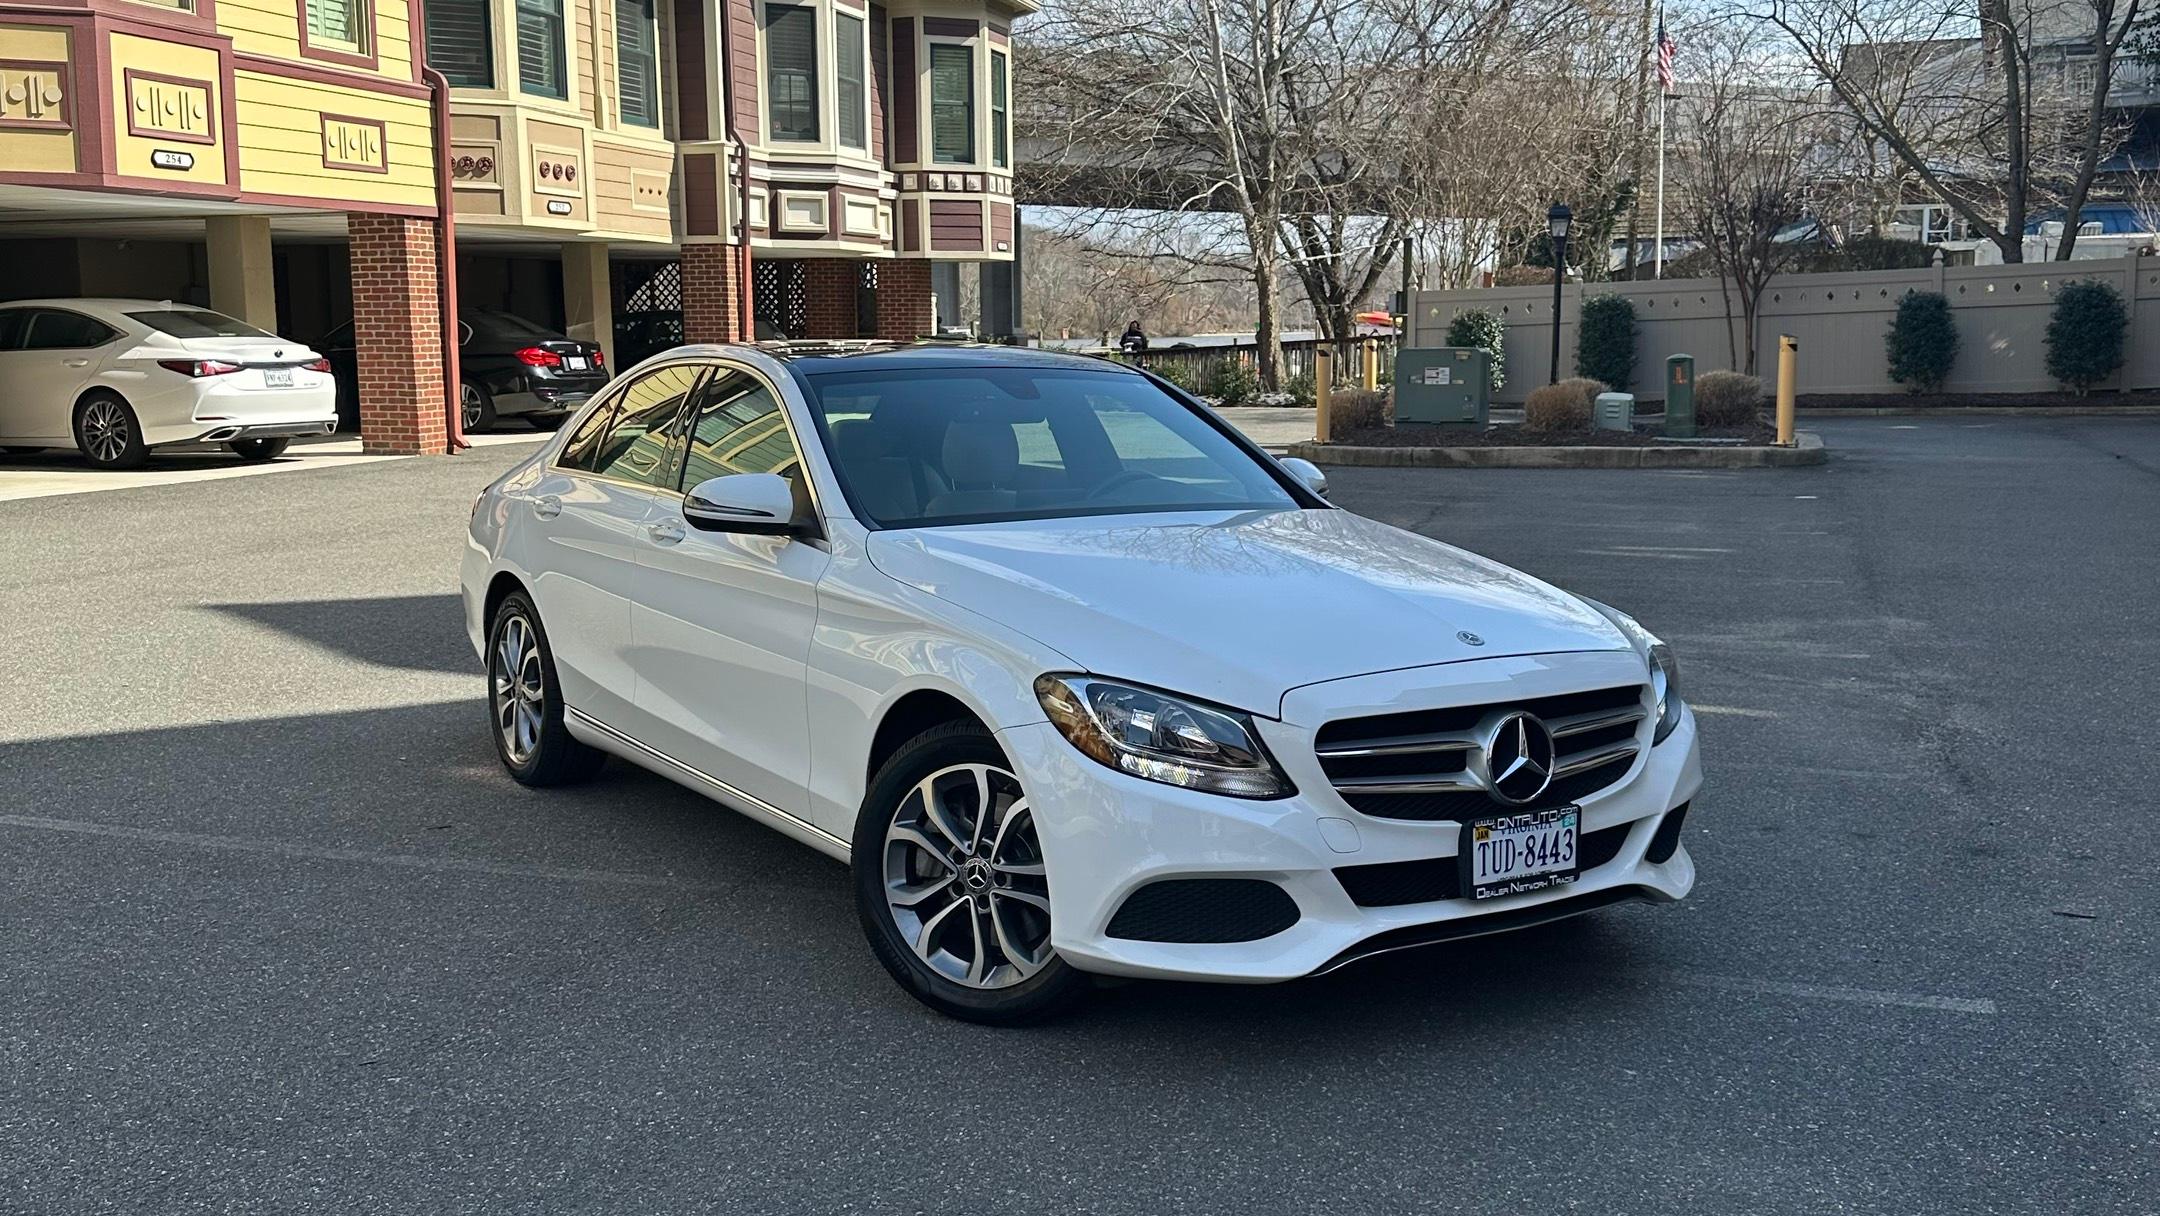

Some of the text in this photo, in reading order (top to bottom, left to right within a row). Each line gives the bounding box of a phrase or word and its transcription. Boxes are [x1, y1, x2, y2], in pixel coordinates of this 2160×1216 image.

[165, 154, 182, 164] 254
[1477, 830, 1489, 841] JAN
[1477, 828, 1574, 877] TUD-8443
